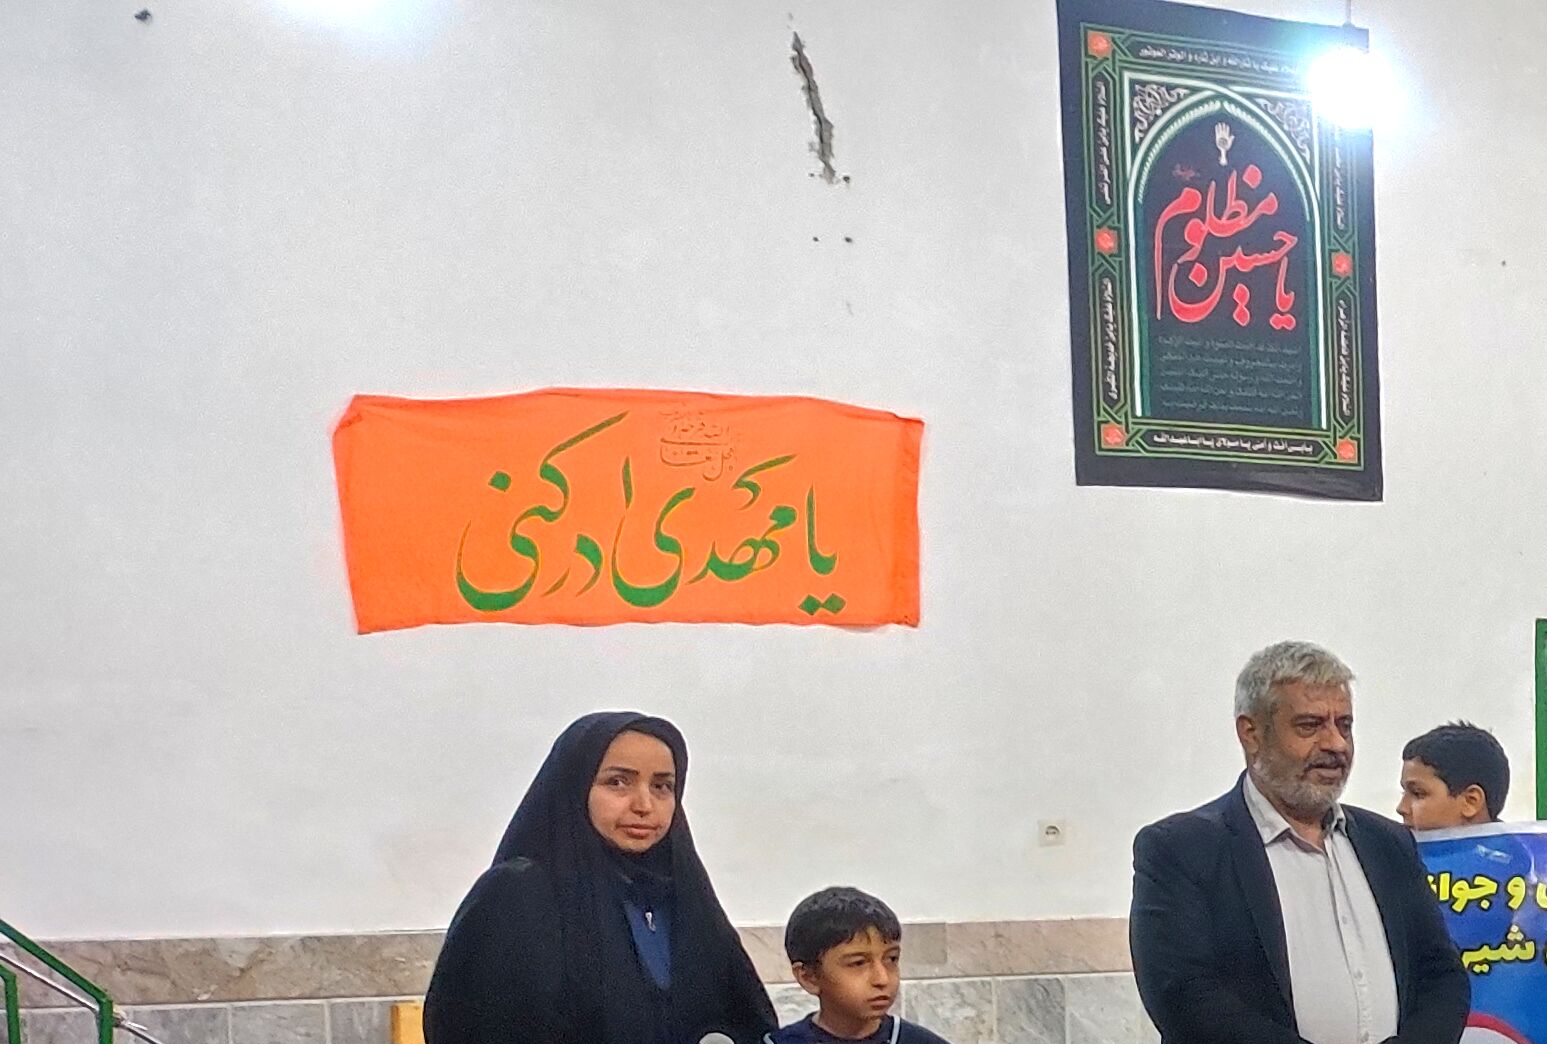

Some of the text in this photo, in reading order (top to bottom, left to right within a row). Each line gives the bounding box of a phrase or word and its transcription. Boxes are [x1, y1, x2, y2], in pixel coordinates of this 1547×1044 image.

[1168, 229, 1298, 330] یا حسین
[610, 452, 798, 609] مهدی
[798, 485, 847, 617] یا
